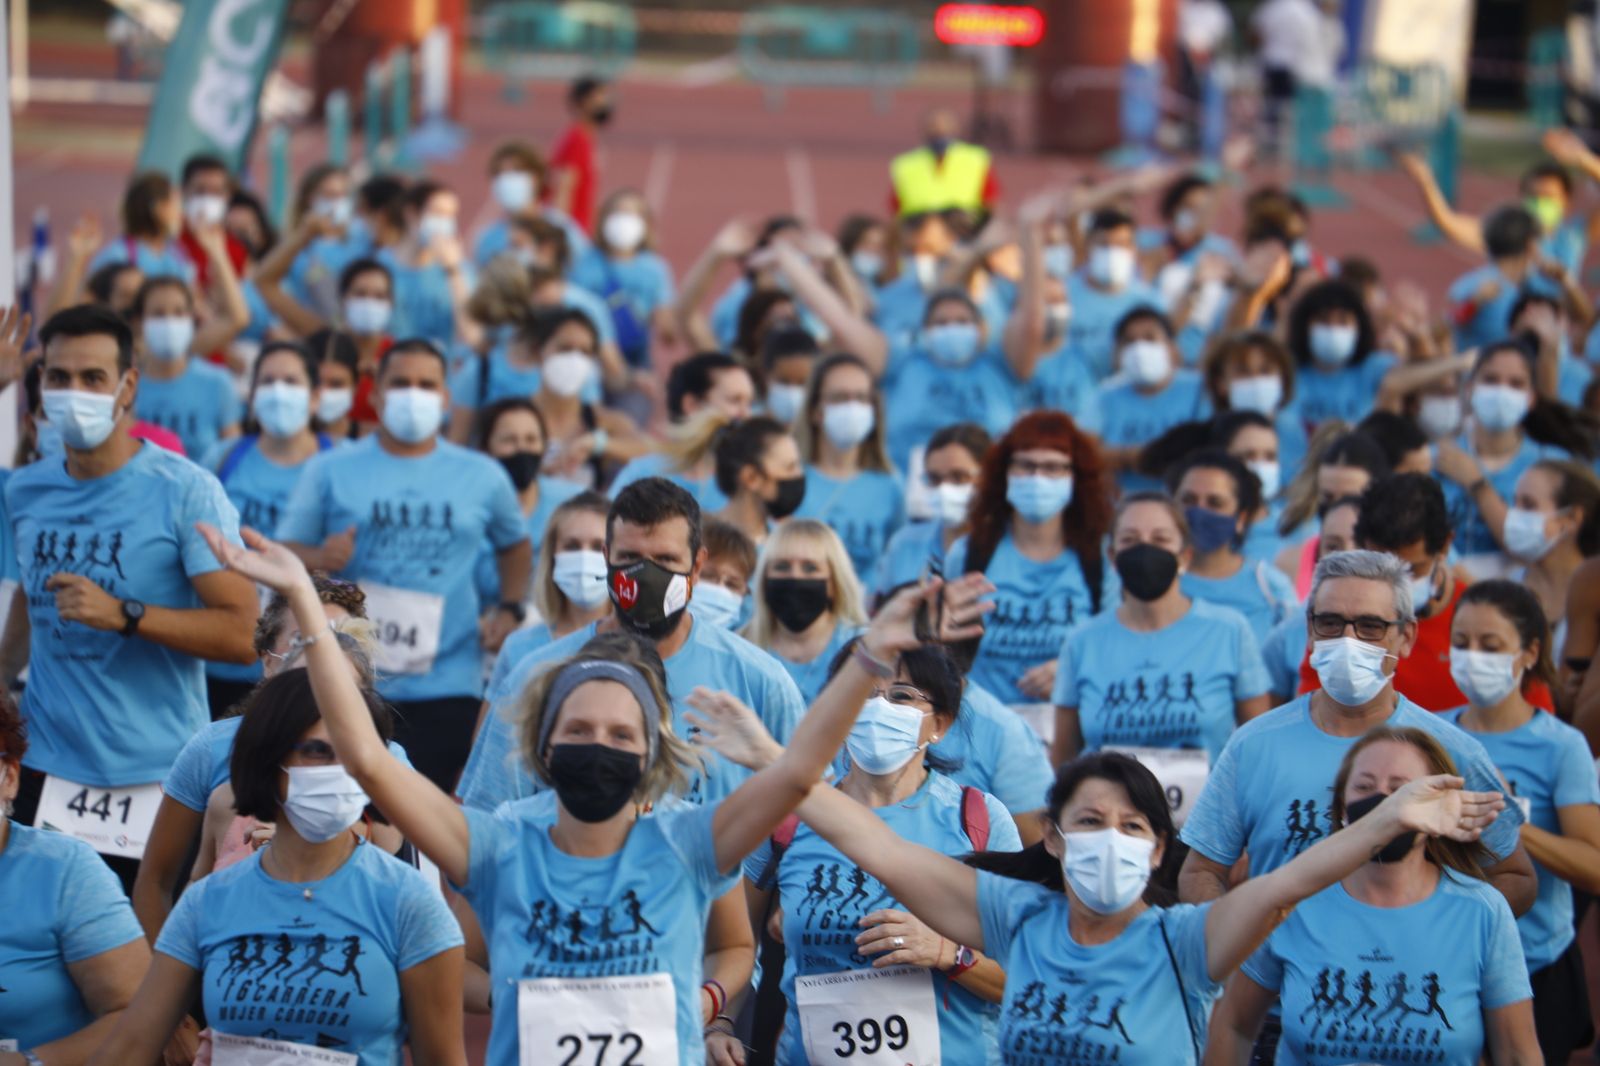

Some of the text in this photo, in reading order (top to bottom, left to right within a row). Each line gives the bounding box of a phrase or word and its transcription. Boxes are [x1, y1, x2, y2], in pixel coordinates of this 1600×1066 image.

[371, 619, 418, 648] 94
[66, 787, 132, 824] 441
[219, 1005, 267, 1022] MUJER
[557, 1031, 644, 1066] 272
[832, 1013, 910, 1058] 399
